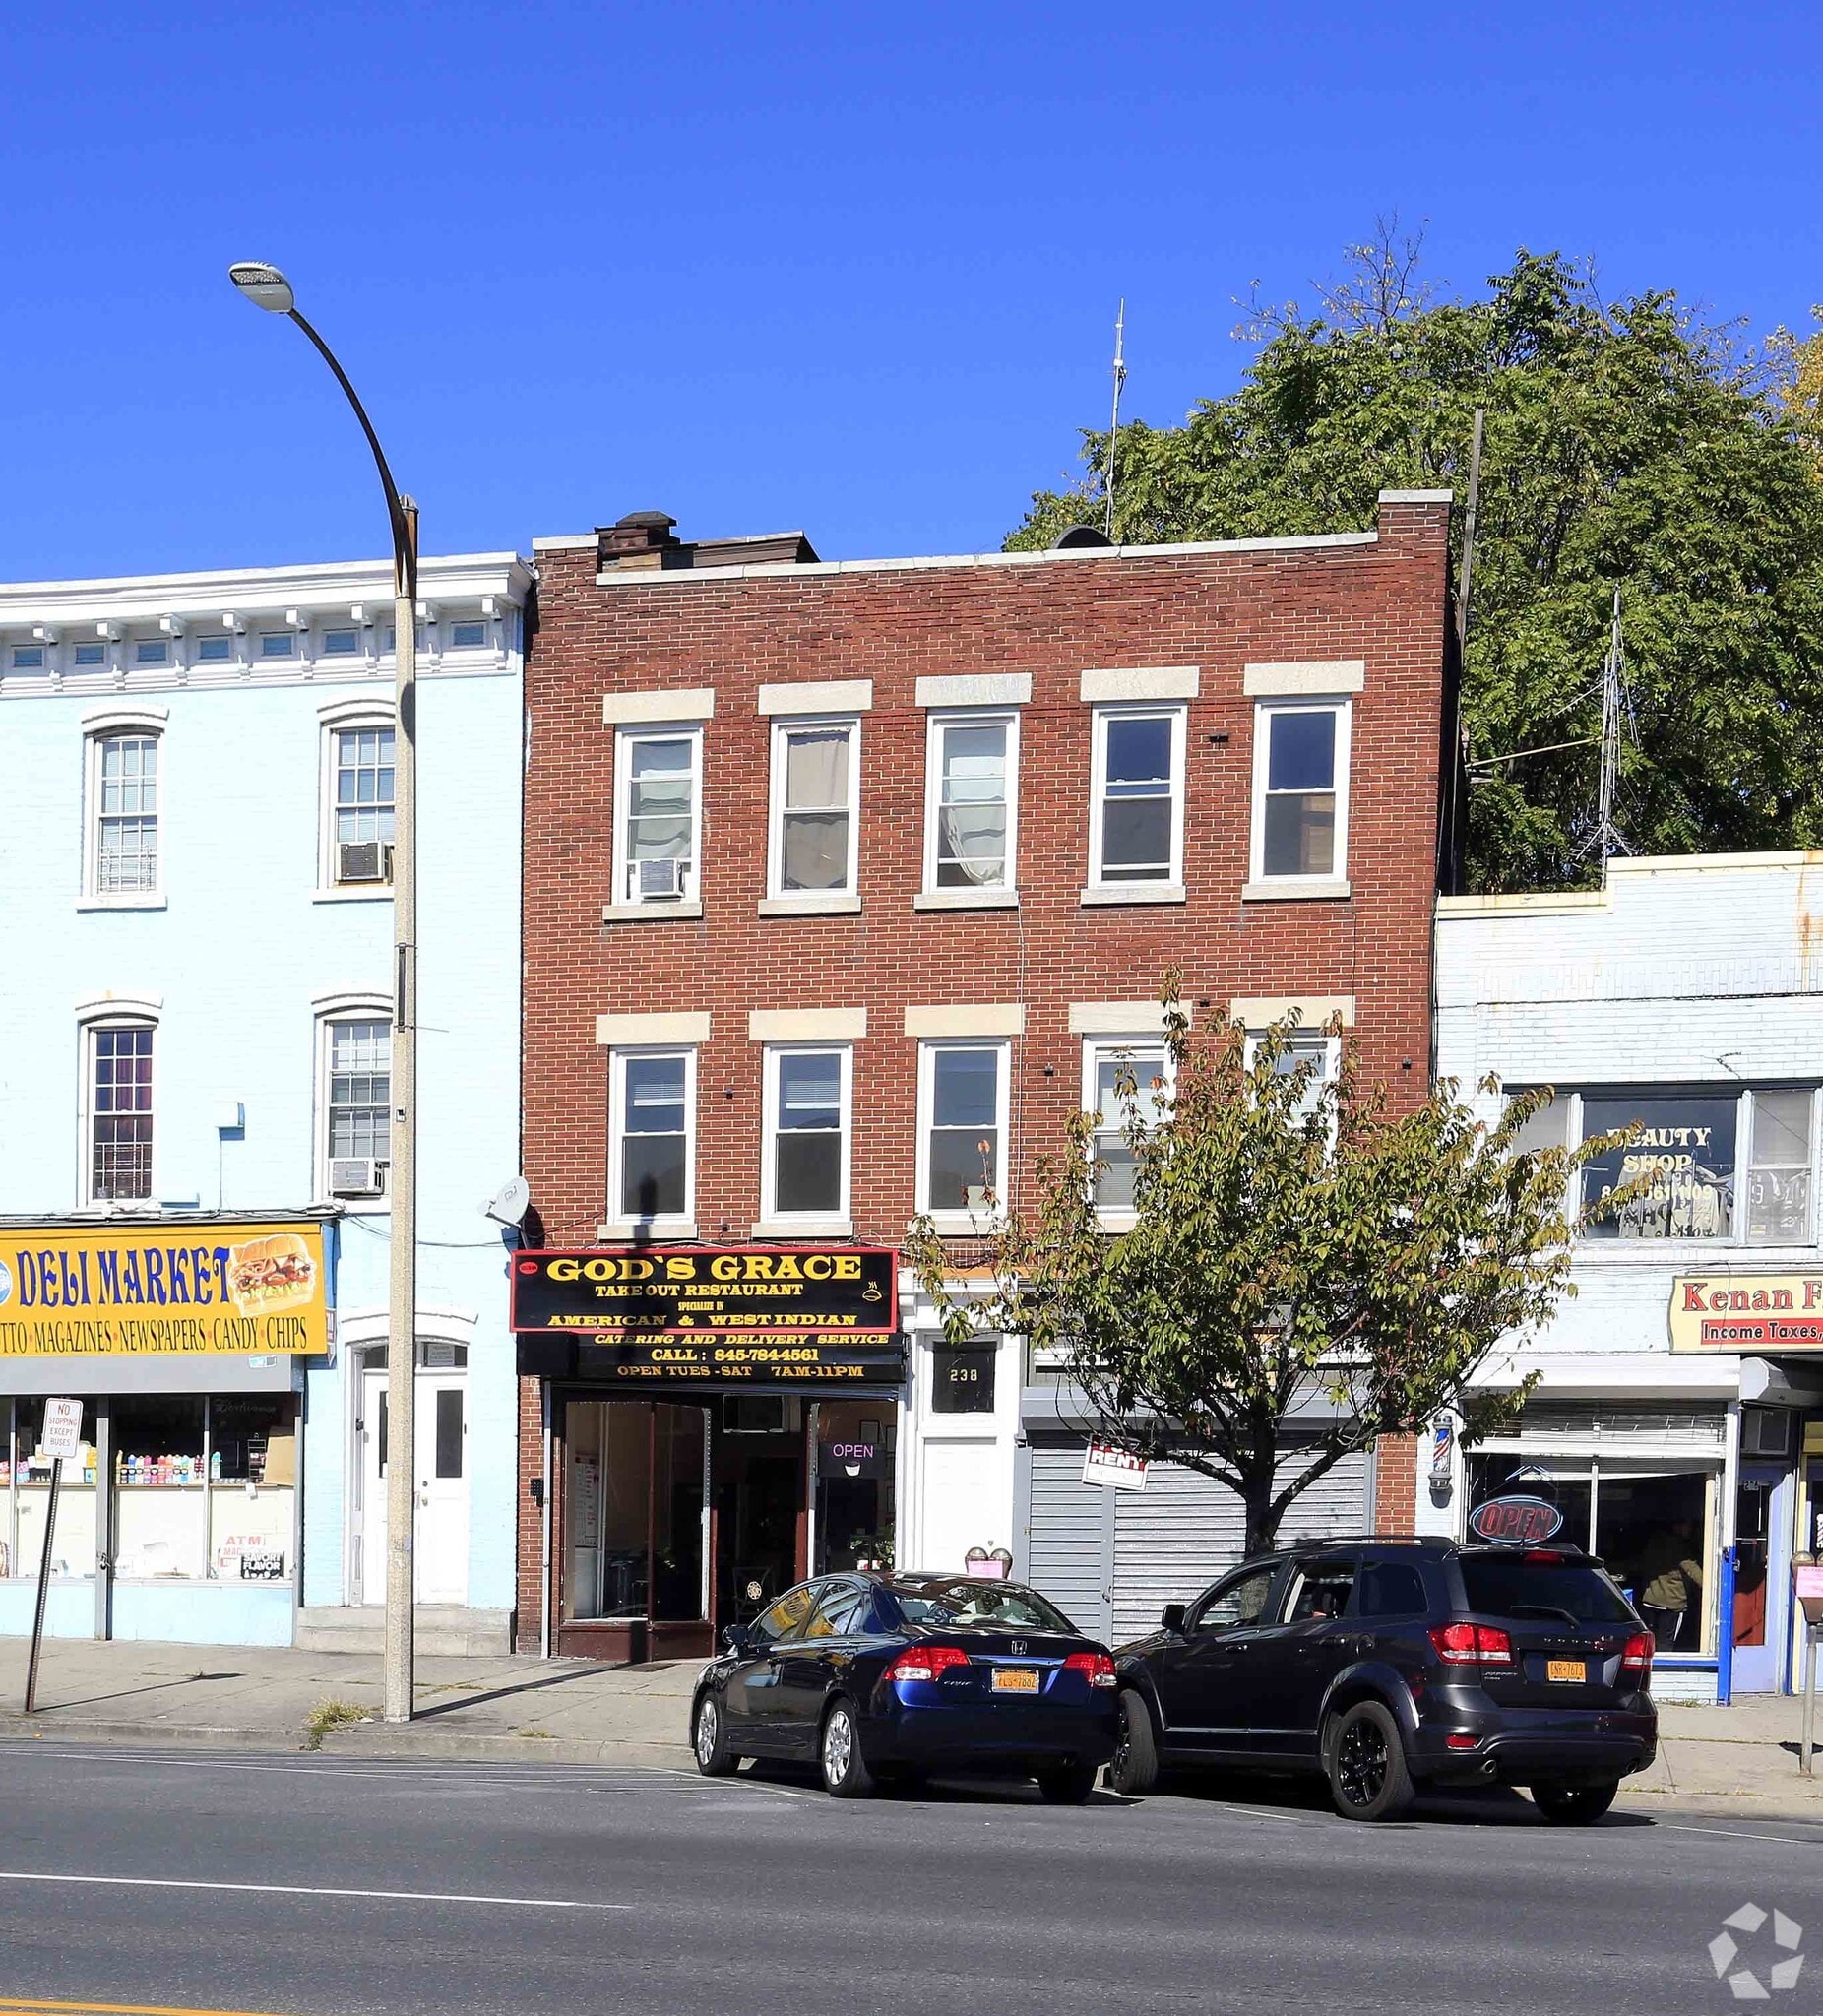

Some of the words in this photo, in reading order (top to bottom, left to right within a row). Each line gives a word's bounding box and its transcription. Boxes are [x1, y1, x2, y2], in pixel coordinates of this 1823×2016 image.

[1623, 1154, 1694, 1173] SHOP
[711, 1255, 861, 1281] GRACE
[16, 1249, 91, 1307] DELI
[96, 1246, 230, 1306] MARKET
[596, 1285, 642, 1297] TAKE
[646, 1285, 681, 1296] OUT
[684, 1284, 804, 1296] RESTAURANT
[1682, 1282, 1794, 1311] Kenan
[717, 1301, 724, 1311] IN
[547, 1314, 667, 1327] AMERICAN
[678, 1315, 695, 1326] &
[708, 1314, 772, 1326] WEST
[775, 1314, 858, 1326] INDIAN
[33, 1320, 112, 1353] MAGAZINES
[119, 1318, 206, 1352] NEWSPAPERS
[213, 1317, 259, 1350] CANDY
[266, 1316, 307, 1349] CHIPS
[1704, 1323, 1764, 1340] Income
[595, 1334, 675, 1345] CATERING
[681, 1334, 717, 1345] AND
[723, 1334, 809, 1345] DELIVERY
[817, 1334, 889, 1344] SERVICE
[617, 1365, 662, 1376] OPEN
[666, 1365, 711, 1376] TUES
[771, 1365, 864, 1377] 7AM-11PM
[949, 1368, 978, 1382] 238
[57, 1403, 71, 1416] NO
[48, 1417, 78, 1426] STOPPING
[49, 1427, 74, 1437] EXCEPT
[49, 1437, 71, 1447] BUSES
[833, 1443, 874, 1458] OPEN
[1090, 1449, 1143, 1471] RENT
[1479, 1503, 1554, 1541] OPEN
[225, 1536, 262, 1545] ATM
[242, 1561, 281, 1571] FLAVOR
